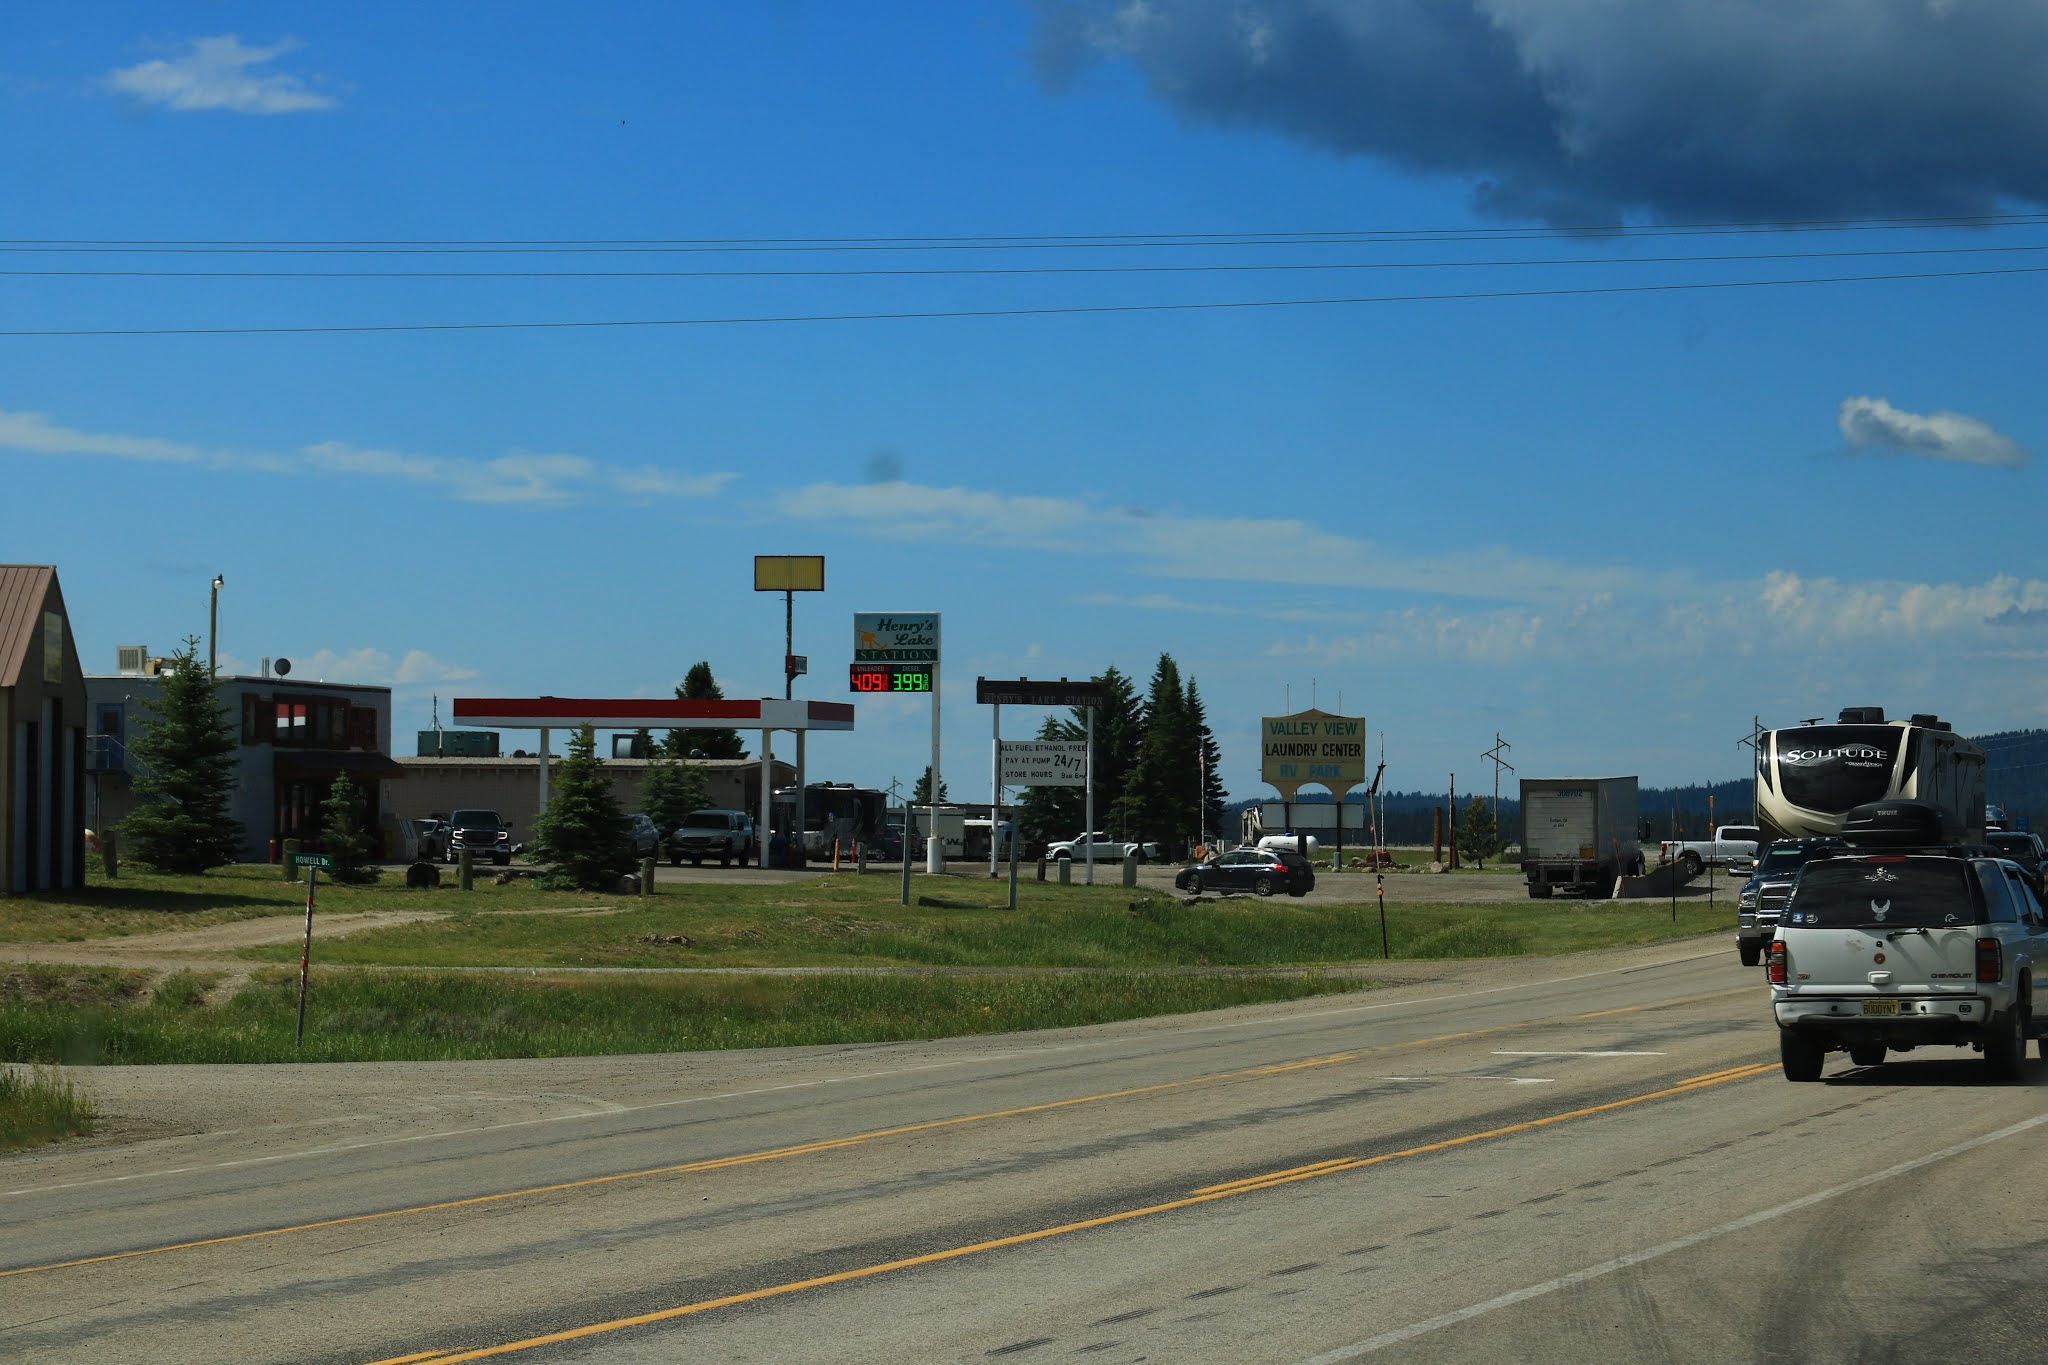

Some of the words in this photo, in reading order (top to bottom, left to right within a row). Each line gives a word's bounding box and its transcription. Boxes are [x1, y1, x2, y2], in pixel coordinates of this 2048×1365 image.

[878, 618, 933, 634] Henry's
[894, 633, 934, 646] Lake
[860, 650, 932, 660] STATION
[984, 695, 1023, 704] HENRY'S
[1031, 695, 1057, 704] LAKE
[1064, 696, 1104, 705] STATION
[1270, 721, 1318, 736] VALLEY
[1324, 722, 1358, 736] VIEW
[1001, 744, 1013, 752] ALL
[1015, 744, 1033, 752] FUEL
[1035, 744, 1066, 752] ETHANOL
[1068, 744, 1086, 752] FREE
[1265, 743, 1318, 757] LAUNDRY
[1322, 743, 1361, 757] CENTER
[1054, 754, 1082, 772] 24/7
[1785, 749, 1888, 763] SOLITUDE
[1280, 764, 1298, 778] RV
[1308, 764, 1343, 778] PARK
[295, 856, 320, 865] HOWELL
[321, 858, 330, 866] Dr.
